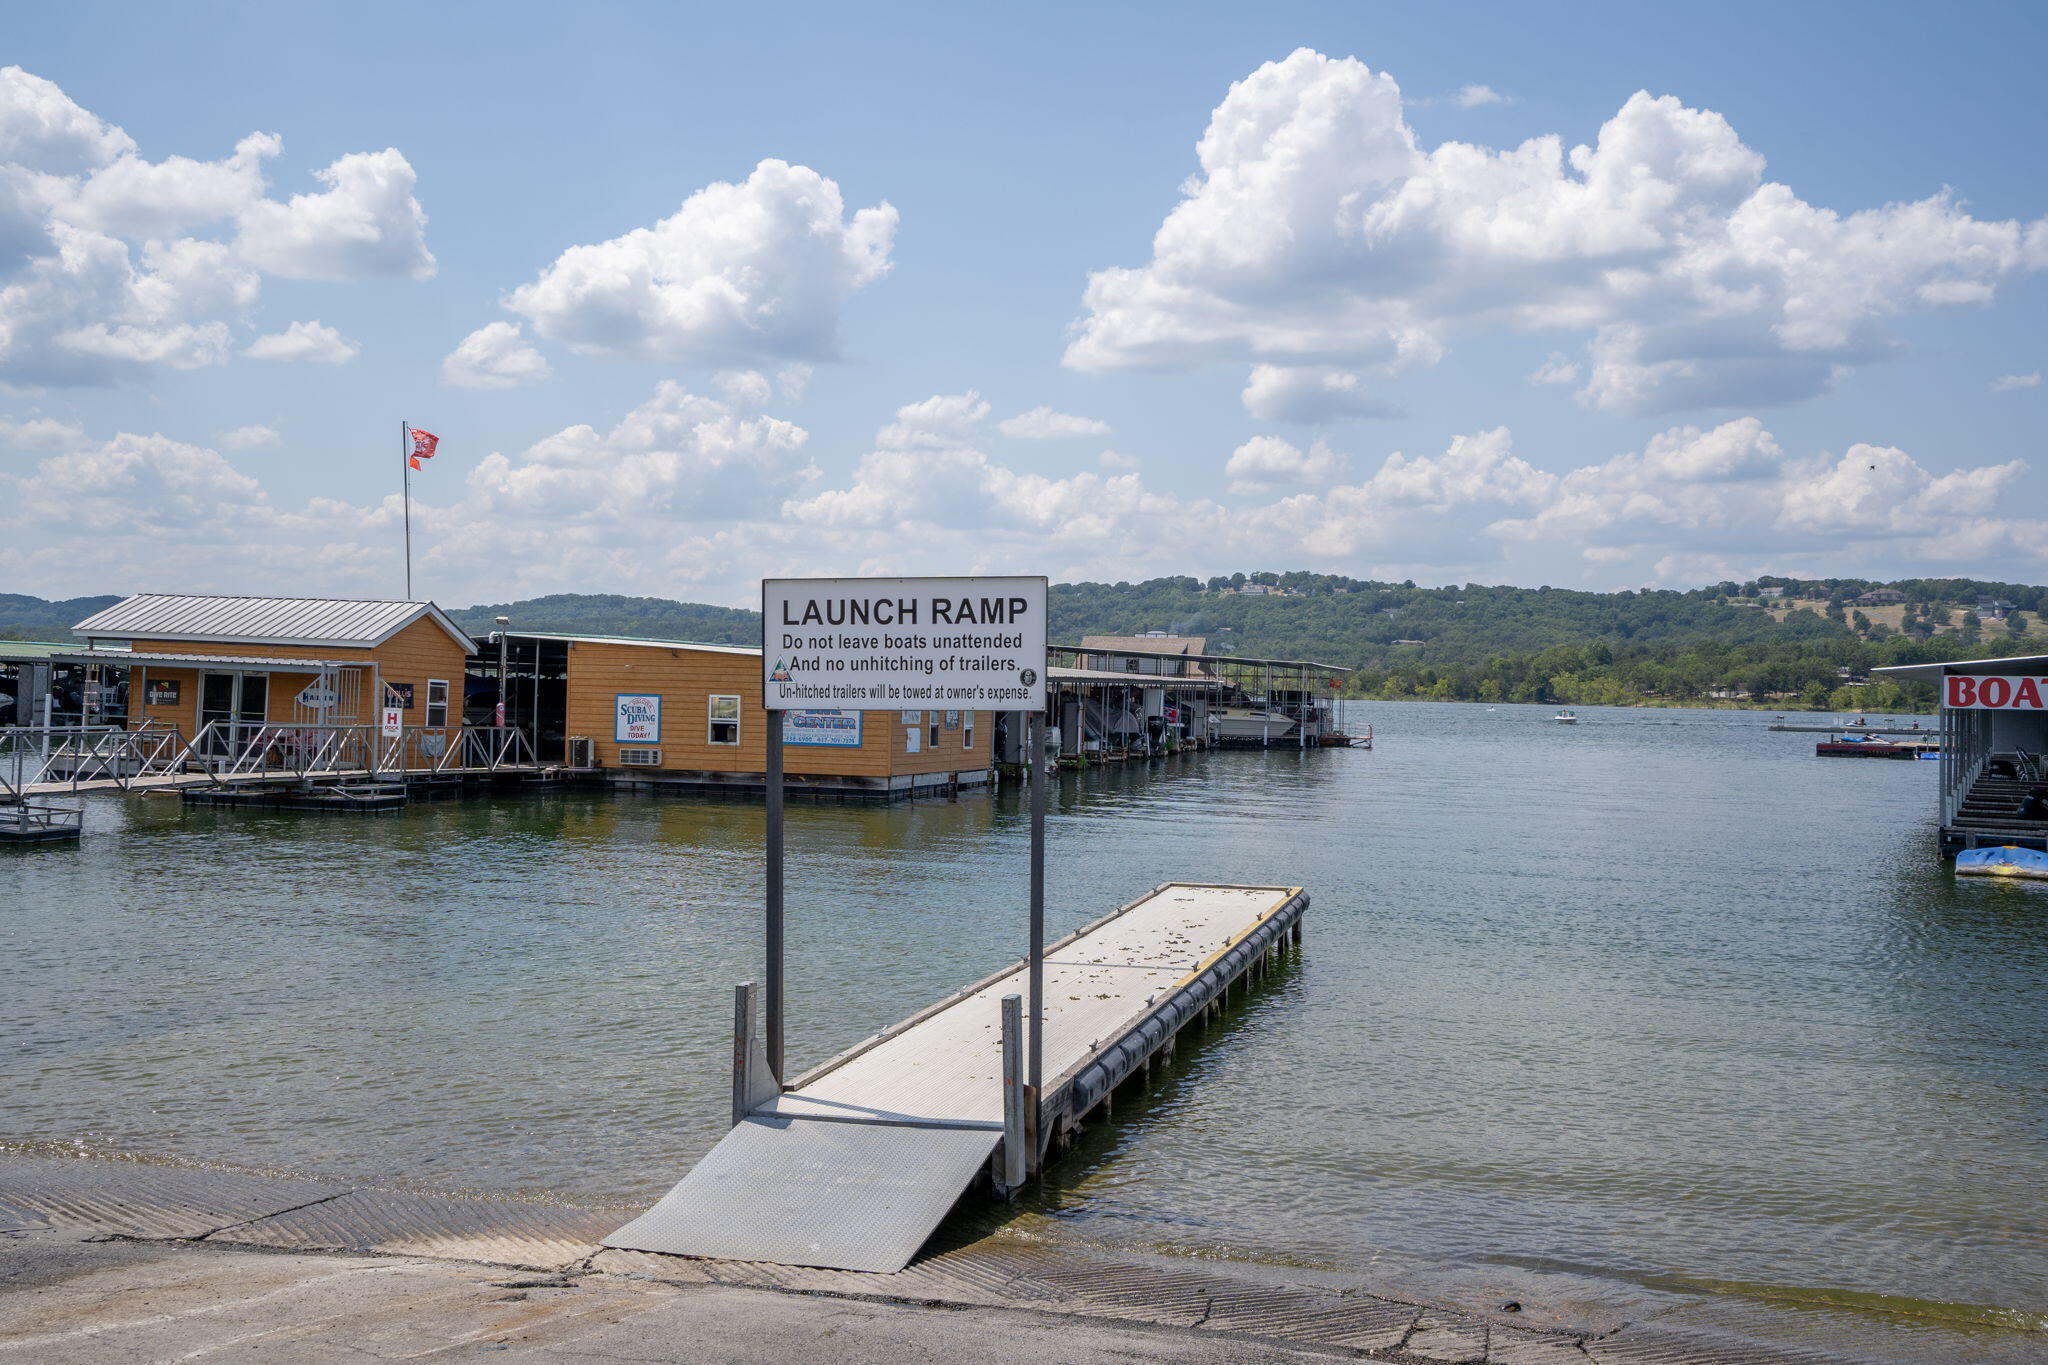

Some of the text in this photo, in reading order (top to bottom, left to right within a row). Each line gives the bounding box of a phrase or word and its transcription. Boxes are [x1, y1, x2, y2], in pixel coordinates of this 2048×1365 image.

[783, 597, 1029, 626] LAUNCH RAMP
[782, 632, 1022, 650] Do not leave boats unattended
[790, 655, 1021, 675] And no unhitching of trailers.
[779, 683, 1032, 704] Un-hitched trailers will be towed at owner's expense.
[1948, 677, 2048, 708] BOA
[387, 712, 398, 725] H
[621, 704, 647, 715] SCUBA
[627, 714, 655, 724] DIVING
[792, 716, 857, 730] CENTER
